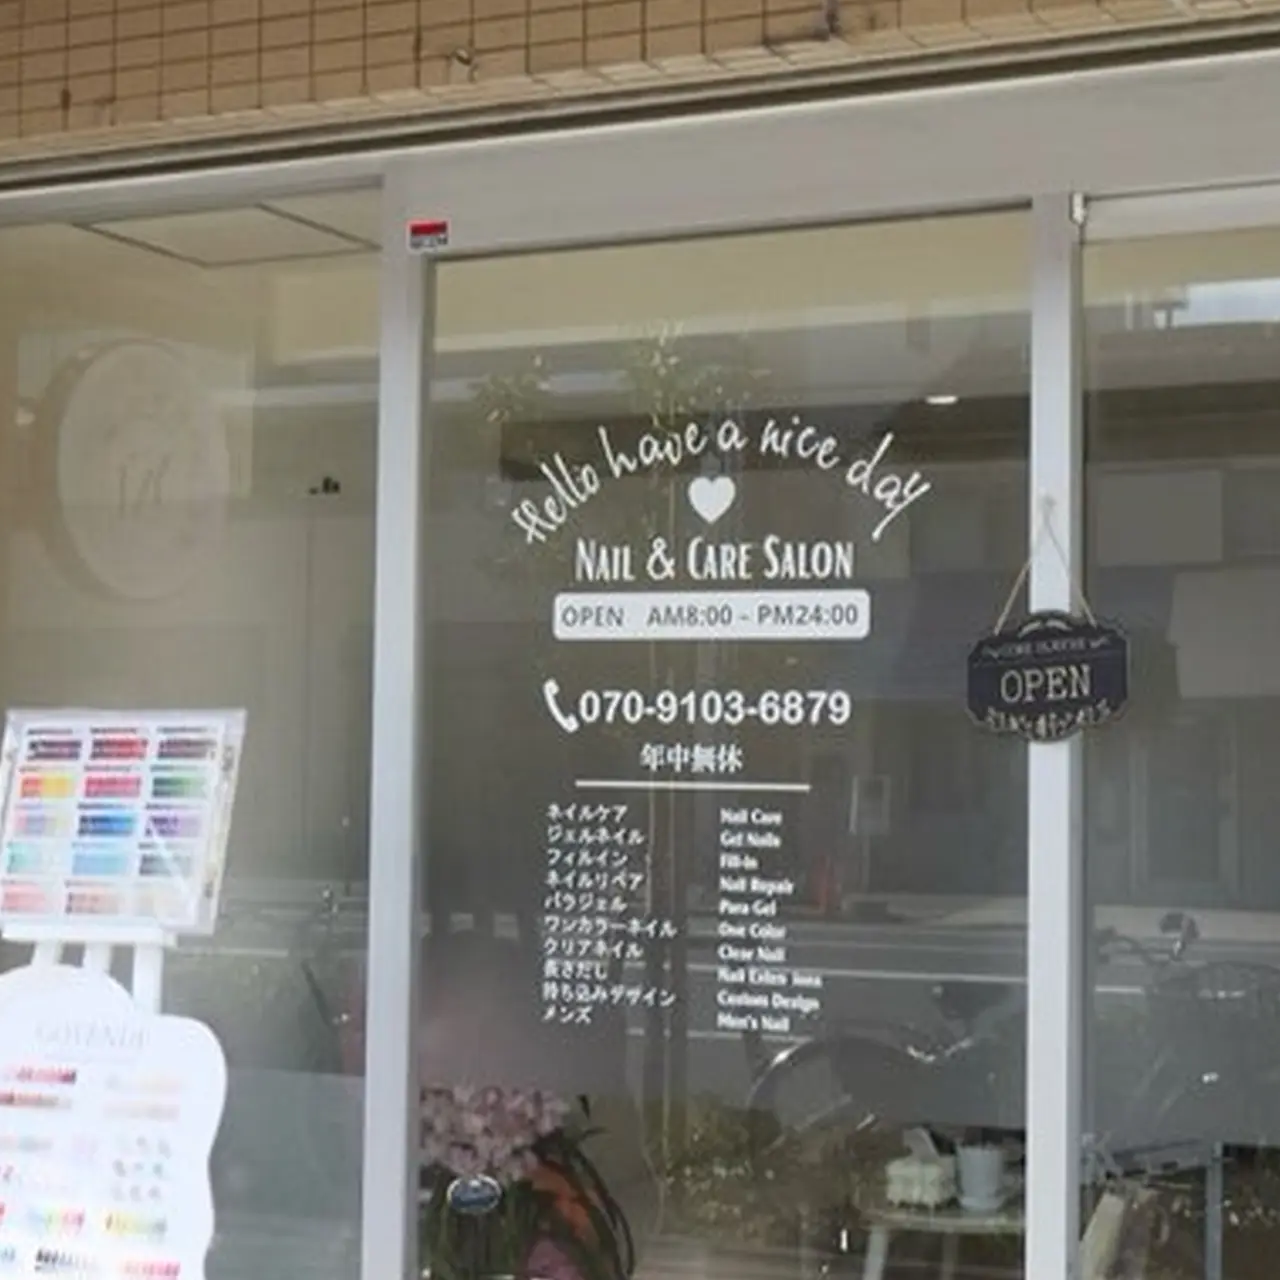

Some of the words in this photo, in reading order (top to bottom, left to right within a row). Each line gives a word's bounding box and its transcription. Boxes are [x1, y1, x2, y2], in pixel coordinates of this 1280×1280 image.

[511, 452, 600, 543] Hello
[597, 424, 709, 478] have
[717, 419, 749, 451] a
[760, 416, 841, 469] nice
[845, 431, 931, 541] day
[646, 536, 676, 580] &
[561, 606, 625, 627] OPEN
[646, 605, 733, 627] AM8:00
[757, 604, 858, 626] PM24:00
[1001, 663, 1090, 703] OPEN
[578, 689, 852, 725] 070-9103-6879
[639, 742, 744, 772] 年中無休
[547, 803, 628, 822] ネイルケア
